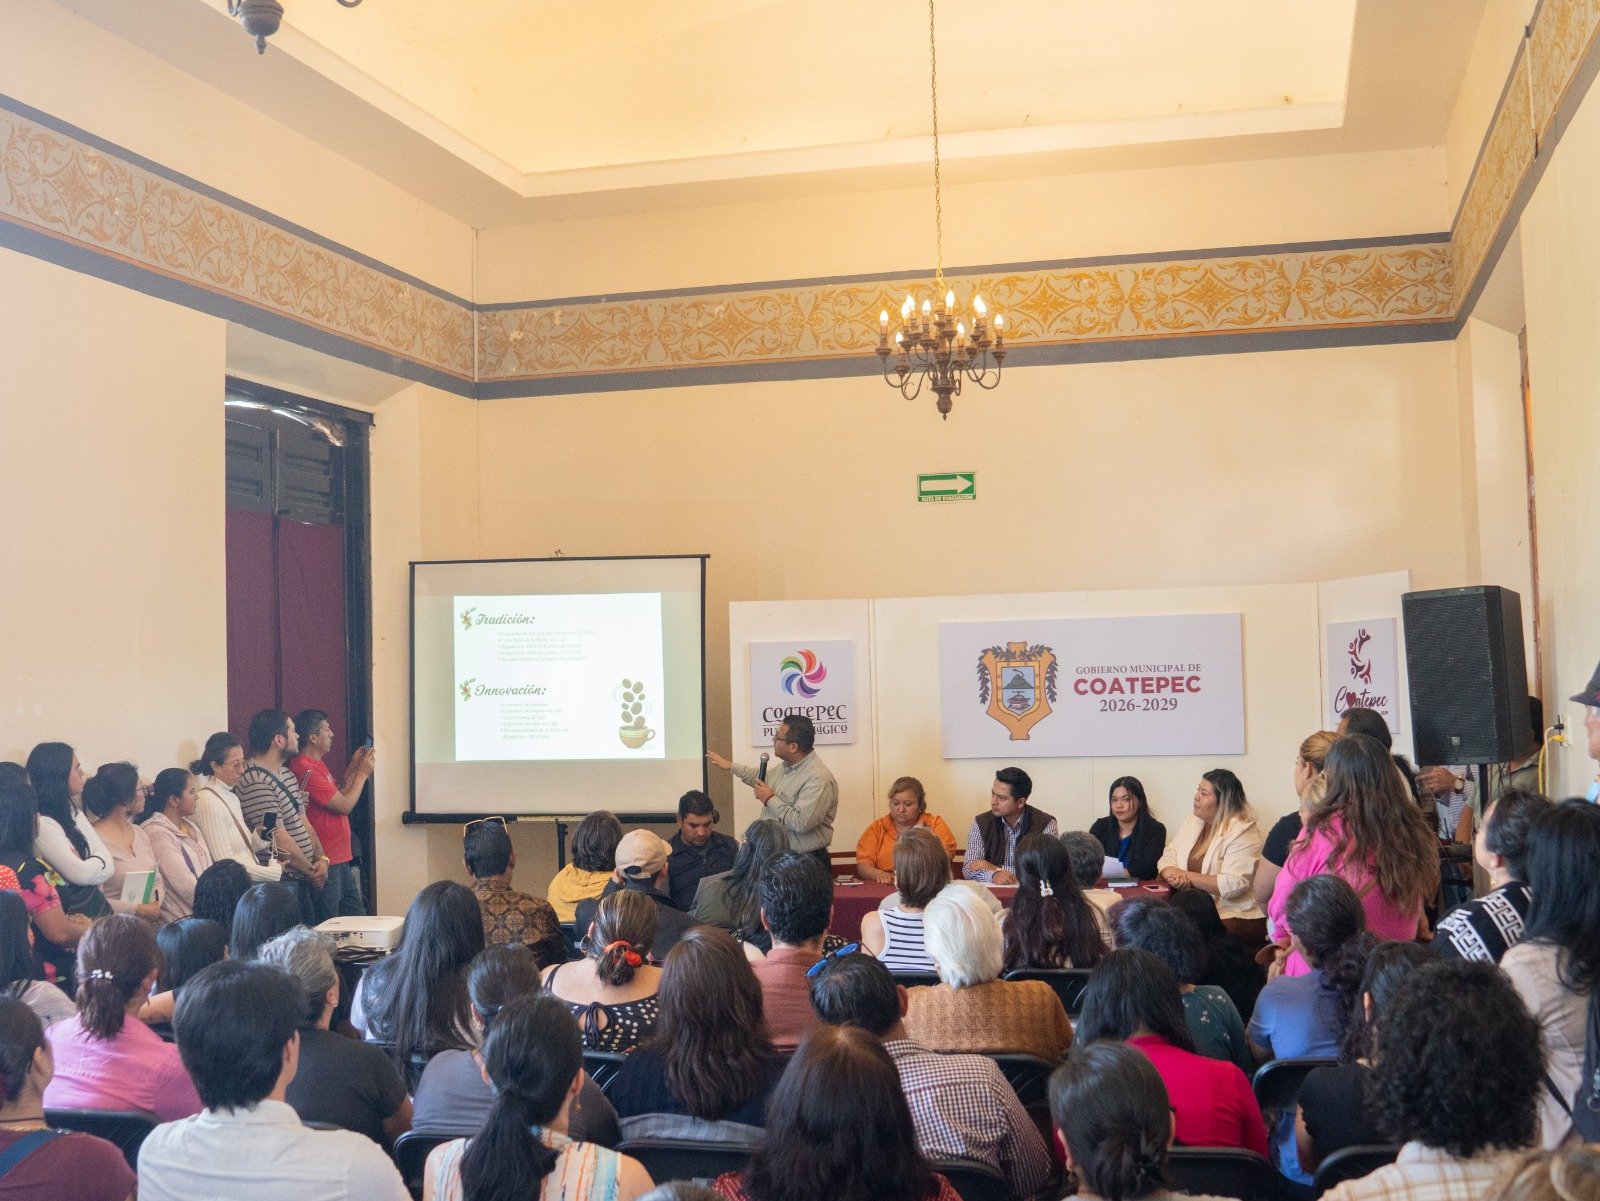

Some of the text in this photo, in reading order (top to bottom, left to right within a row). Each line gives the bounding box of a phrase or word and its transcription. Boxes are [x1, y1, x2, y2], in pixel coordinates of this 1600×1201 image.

[475, 613, 536, 625] Tradición:
[1075, 663, 1202, 675] GOBIERNO MUNICIPAL DE
[474, 684, 547, 697] Innovación:
[1073, 675, 1202, 696] COATEPEC
[1099, 698, 1178, 712] 2026-2029
